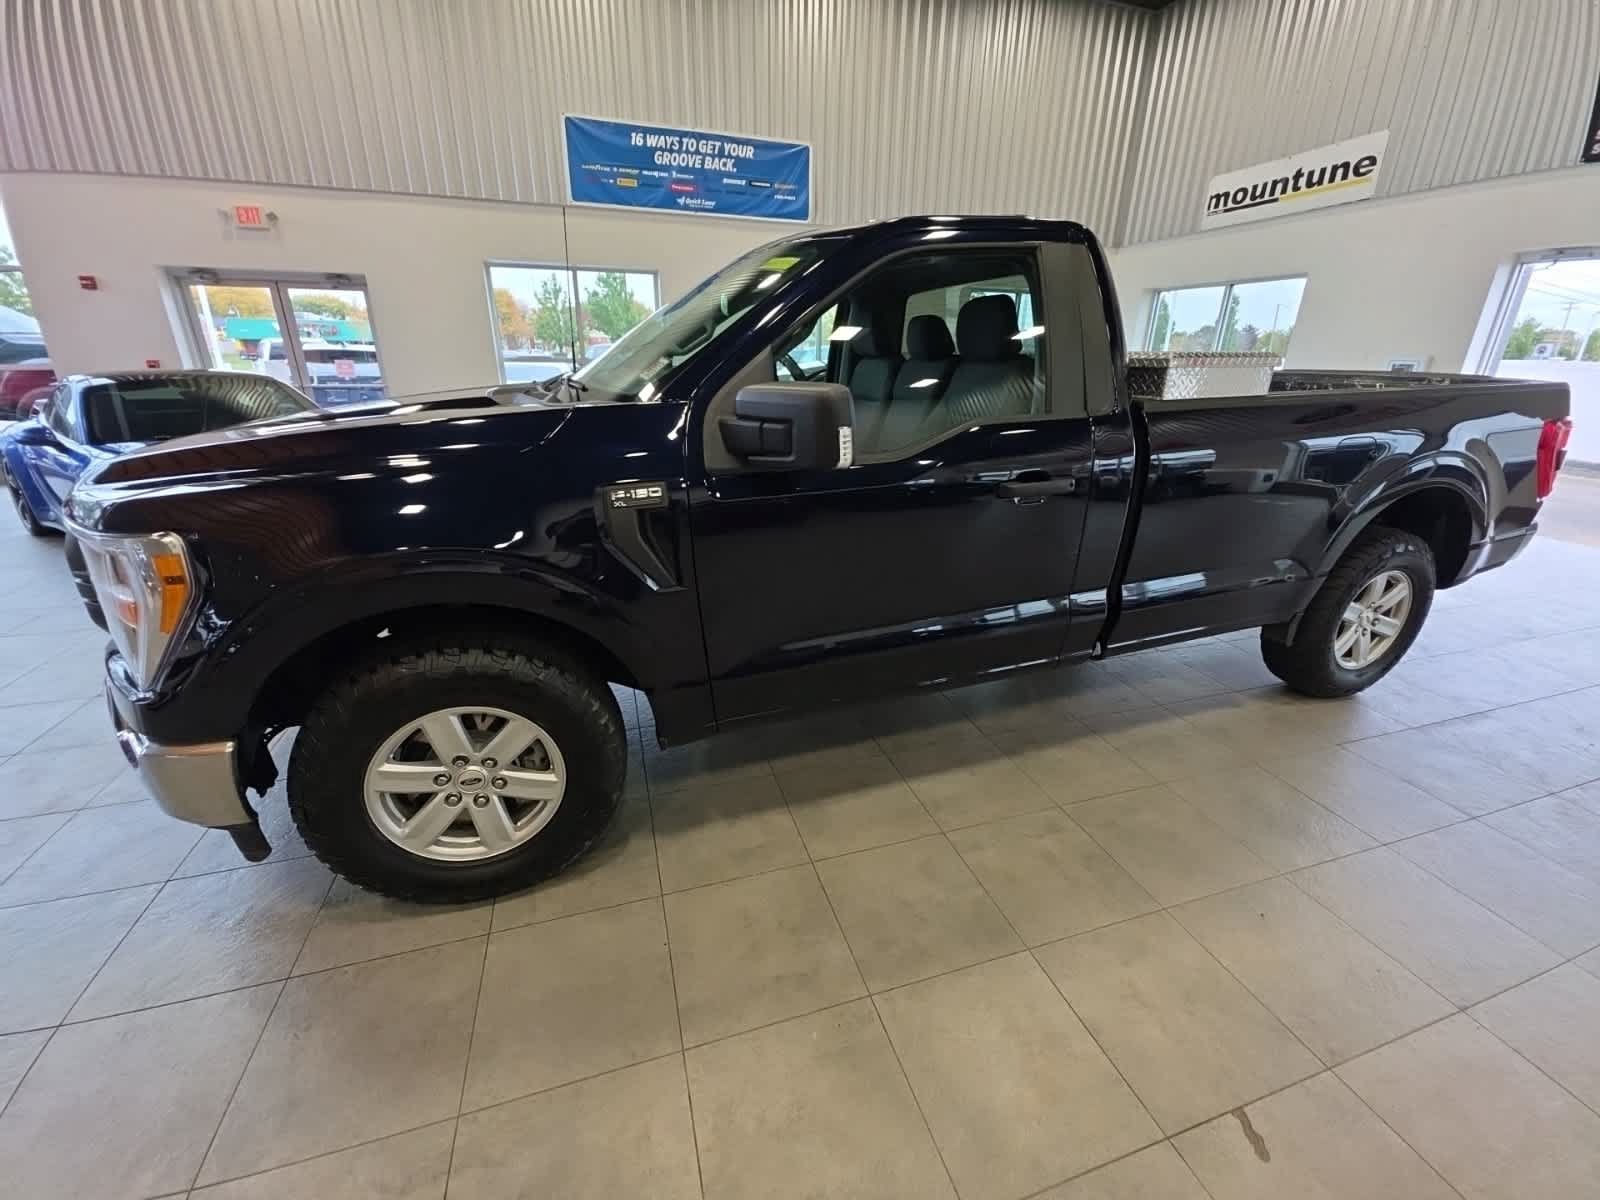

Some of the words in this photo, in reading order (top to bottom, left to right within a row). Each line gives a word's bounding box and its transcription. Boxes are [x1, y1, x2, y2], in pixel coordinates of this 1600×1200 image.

[631, 132, 643, 146] 16
[646, 134, 680, 150] WAYS
[682, 137, 697, 152] TO
[699, 140, 721, 154] GET
[724, 142, 754, 159] YOUR
[654, 151, 701, 168] GROOVE
[704, 157, 737, 172] BACK.
[1207, 155, 1377, 211] mountune
[236, 207, 261, 224] EXIT
[611, 487, 662, 500] F-150
